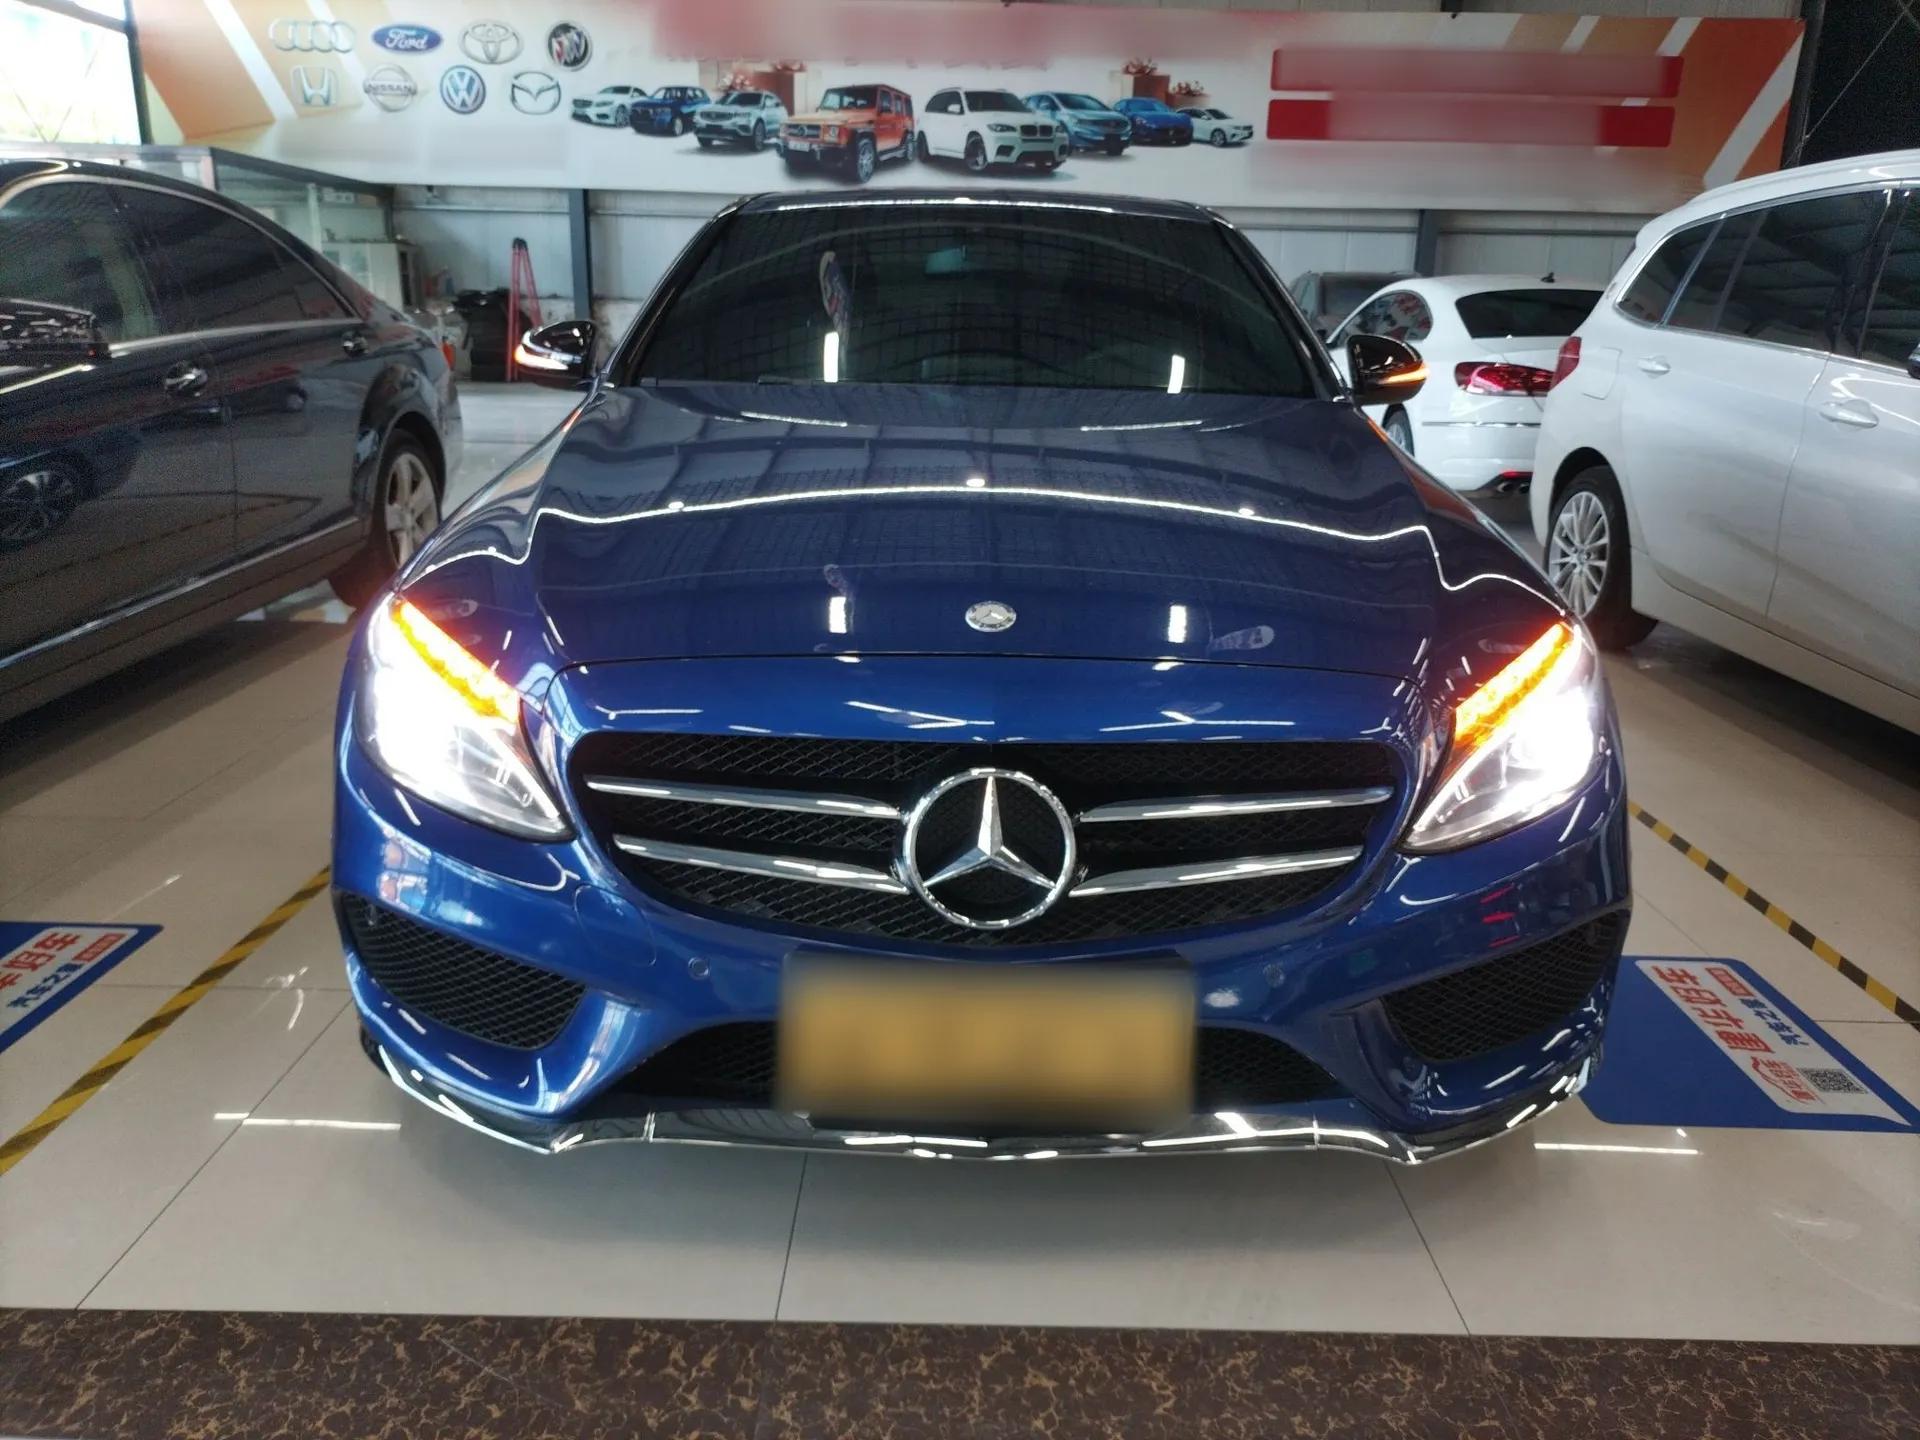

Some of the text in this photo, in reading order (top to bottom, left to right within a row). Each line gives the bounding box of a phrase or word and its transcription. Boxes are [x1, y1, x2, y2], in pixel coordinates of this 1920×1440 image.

[385, 29, 428, 50] Ford
[367, 84, 417, 96] NISSAN
[1651, 965, 1774, 1053] 建华好车
[1739, 998, 1809, 1046] 汽车之家
